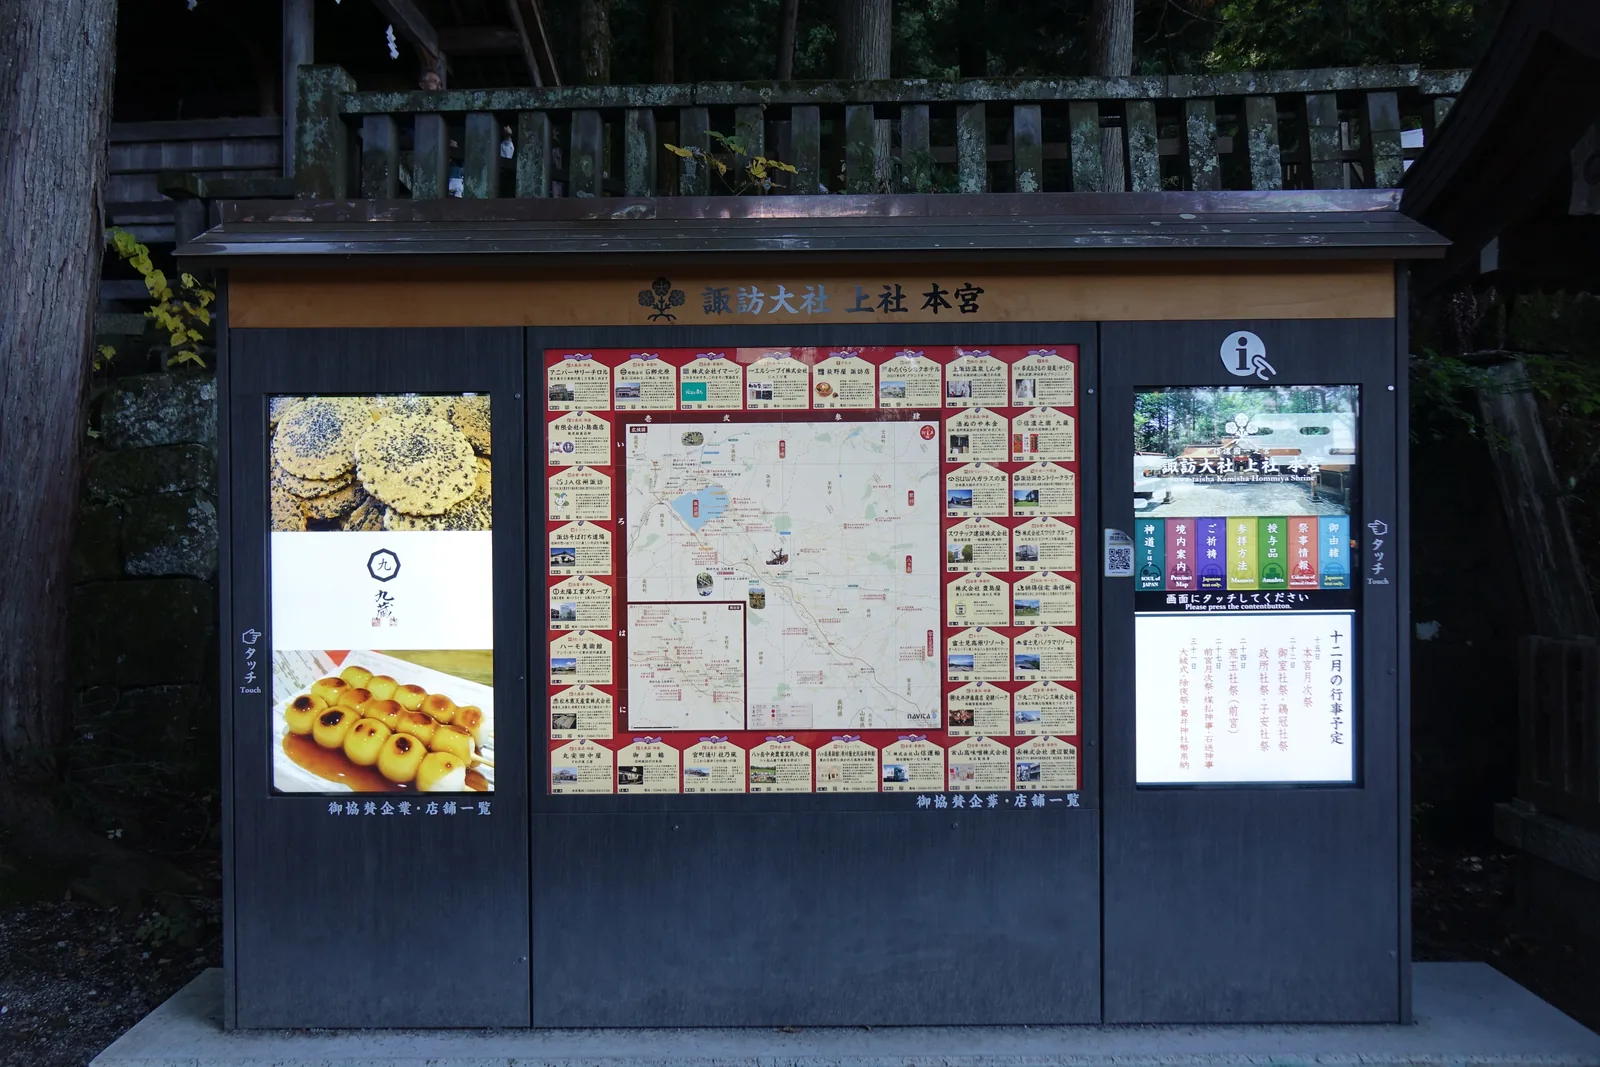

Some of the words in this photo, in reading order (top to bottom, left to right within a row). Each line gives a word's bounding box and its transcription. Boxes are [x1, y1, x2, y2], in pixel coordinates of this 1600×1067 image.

[703, 285, 831, 316] 諏訪大社
[845, 285, 909, 314] 上社
[920, 283, 985, 314] 本宮
[550, 369, 608, 378] アニバーサリーチロル
[888, 366, 940, 374] かたくらシルクホテル
[1162, 457, 1235, 474] 諏訪大社
[1243, 457, 1280, 474] 上社
[1287, 457, 1321, 474] 本宮
[955, 475, 1007, 483] SUWAガラスの里
[1217, 475, 1250, 483] Kamisha
[1251, 474, 1289, 484] Hommiya
[1291, 474, 1316, 482] Shrine
[618, 517, 625, 526] ろ
[556, 533, 605, 541] 諏訪そば打ち道場
[948, 530, 1008, 538] スワテック建設株式会社
[1205, 523, 1218, 560] ご祈祷
[1267, 523, 1279, 558] 授与品
[1328, 522, 1340, 558] 御由緒
[1175, 524, 1187, 572] 境内案内
[1236, 523, 1248, 572] 参拝方法
[1297, 522, 1310, 570] 祭事情報
[378, 558, 391, 571] 九
[1371, 538, 1385, 576] タッチ
[560, 588, 609, 596] 太陽工業グループ
[1166, 593, 1310, 604] 画面にタッチしてください
[619, 629, 626, 637] は
[952, 639, 1006, 647] 富士見高原リゾート
[244, 646, 257, 684] タッチ
[1303, 647, 1314, 708] 本宮月次祭
[1330, 630, 1344, 745] 十二月の行事予定
[328, 801, 492, 816] 御協賛企業・店舗一覧
[916, 793, 1080, 809] 御協賛企業・店舗一覧
